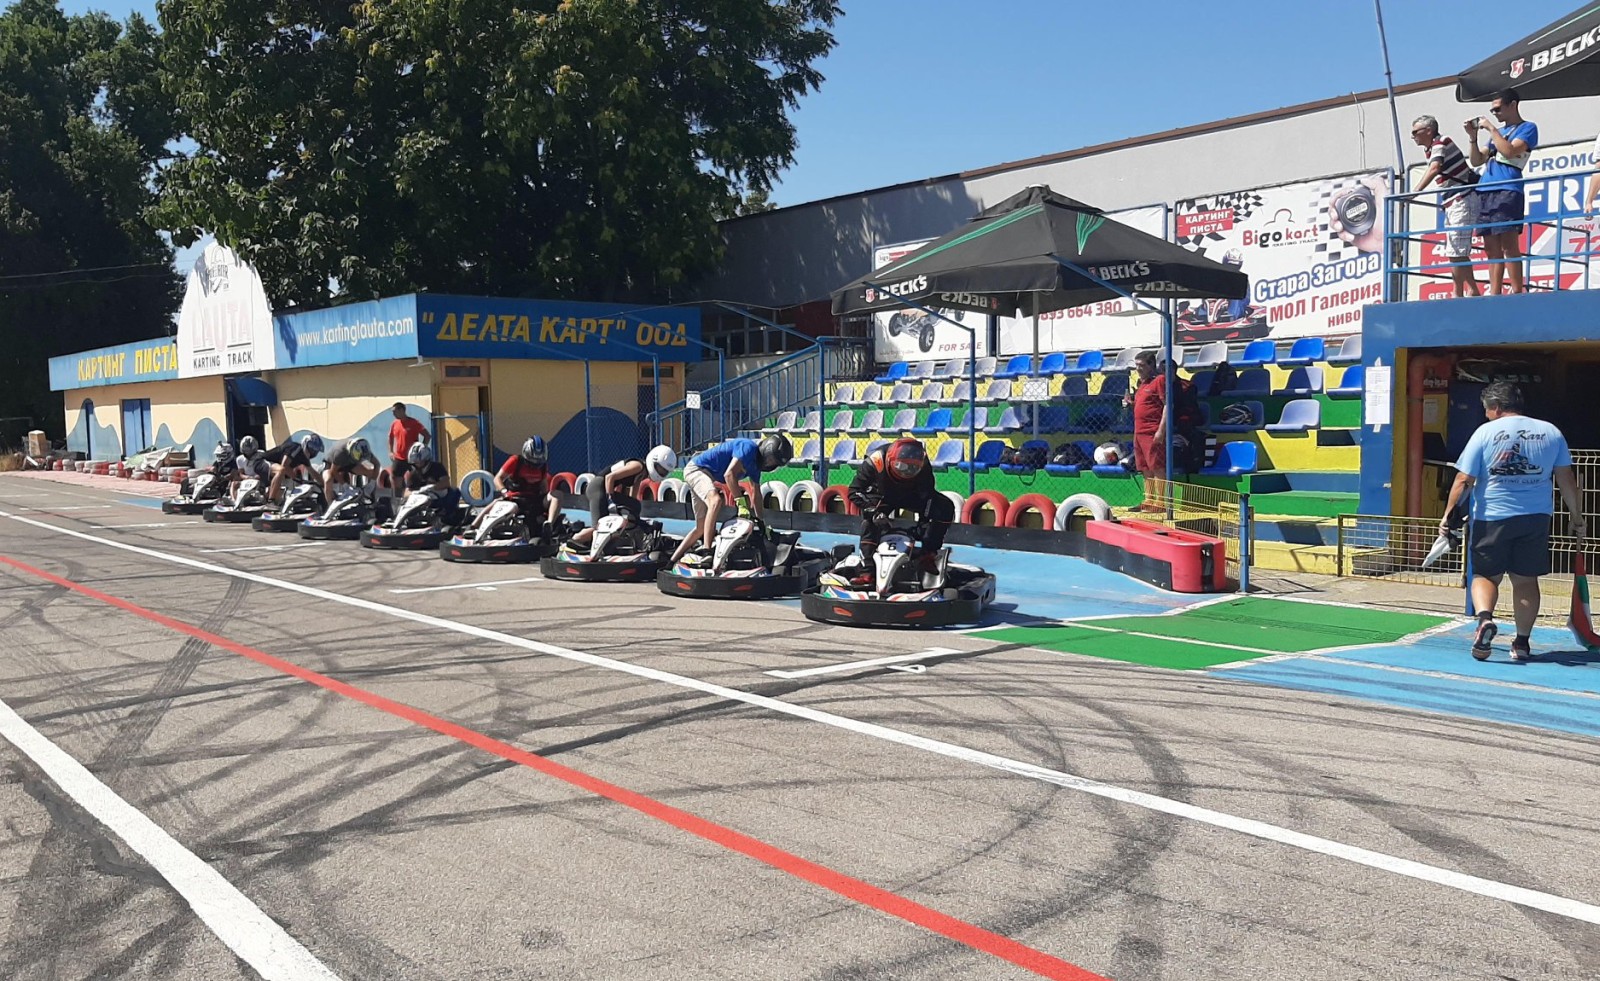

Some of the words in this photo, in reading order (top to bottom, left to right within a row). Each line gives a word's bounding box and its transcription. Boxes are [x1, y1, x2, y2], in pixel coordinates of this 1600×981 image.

[1185, 210, 1231, 224] КАРТИНГ
[1190, 223, 1224, 234] ПИСТА
[1100, 261, 1150, 281] BECK'S
[1255, 271, 1309, 302] Стара
[1311, 252, 1381, 287] Загора
[878, 275, 928, 300] BECK'S
[1095, 301, 1122, 316] 380
[1269, 299, 1306, 323] МОЛ
[1311, 282, 1382, 312] Галерия
[298, 317, 414, 347] www.kartinglauta.com
[636, 321, 688, 346] ООД
[938, 344, 957, 352] FOR
[960, 341, 983, 350] SAE
[78, 352, 125, 380] КАРТИНГ
[135, 343, 178, 375] ПИСТА
[193, 355, 221, 369] KARTING
[227, 351, 253, 367] TRACK
[1493, 430, 1510, 446] Go
[1517, 429, 1546, 440] Kart
[888, 542, 896, 551] 6
